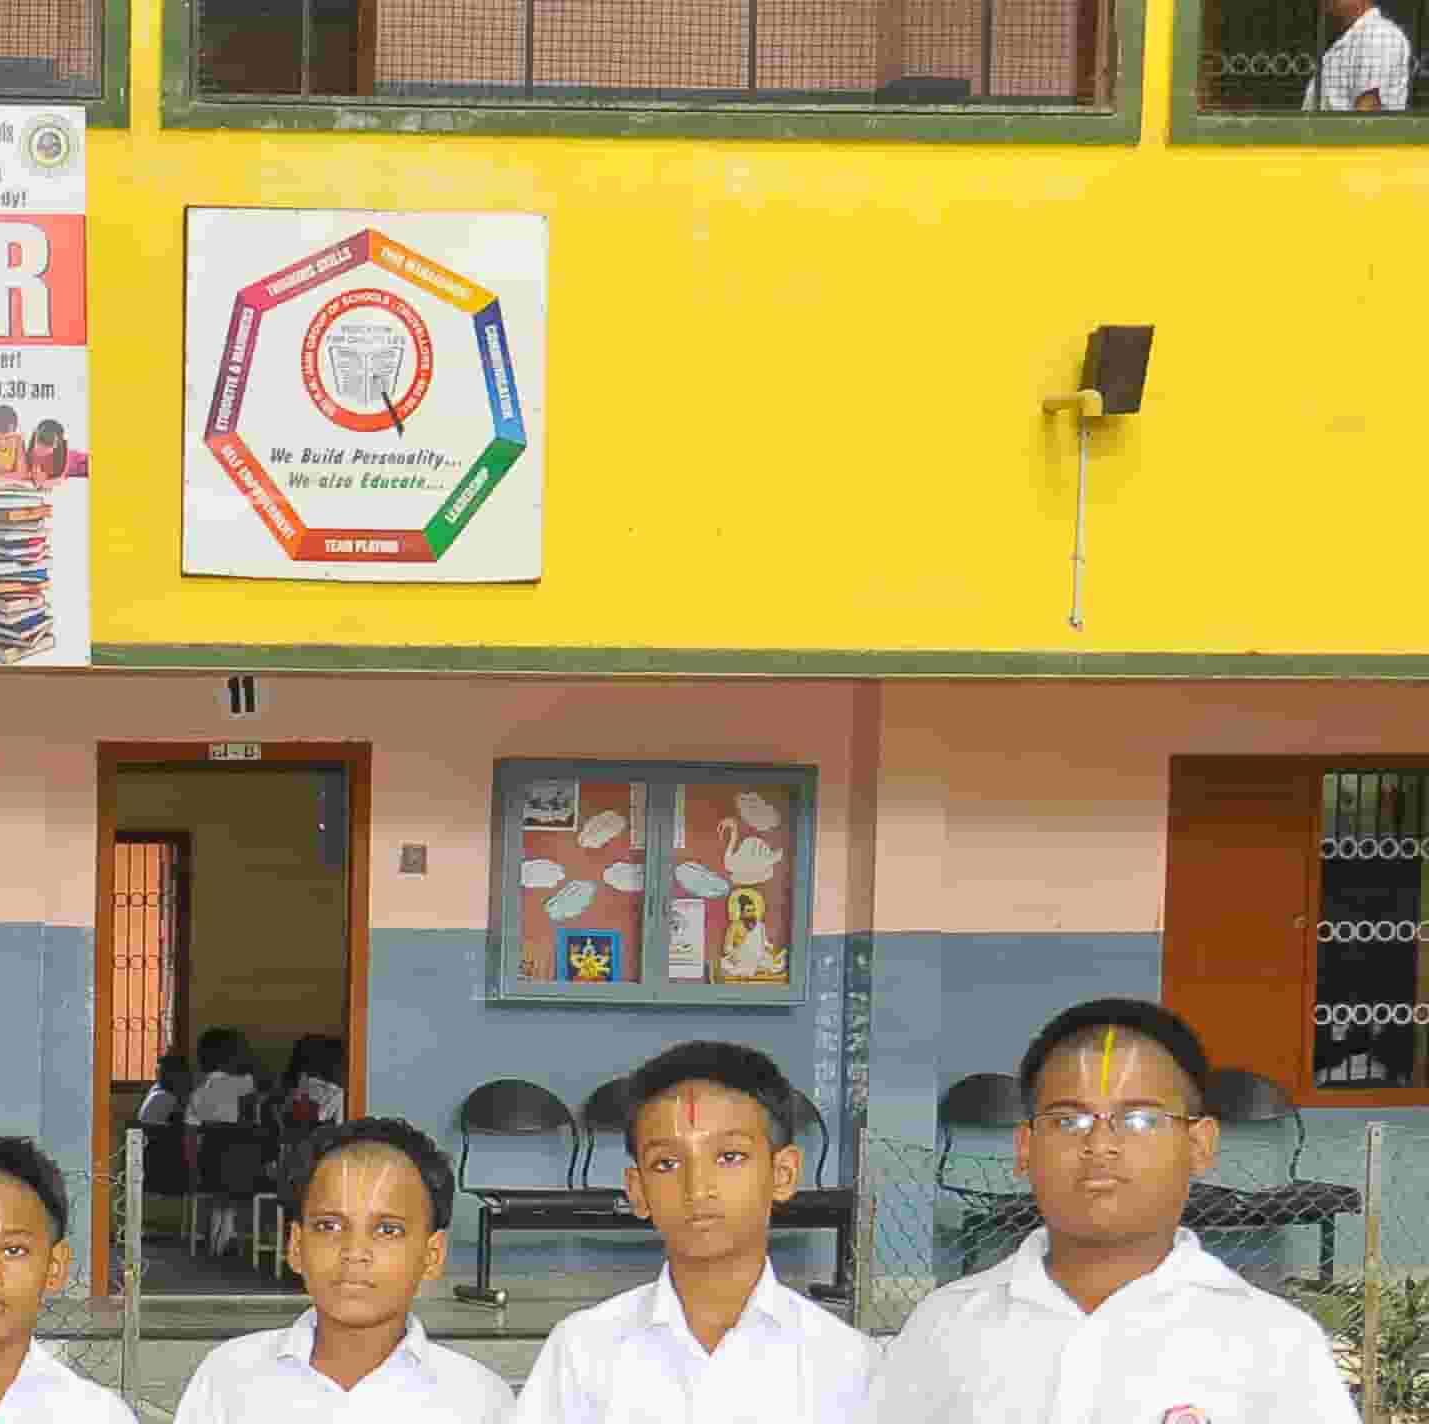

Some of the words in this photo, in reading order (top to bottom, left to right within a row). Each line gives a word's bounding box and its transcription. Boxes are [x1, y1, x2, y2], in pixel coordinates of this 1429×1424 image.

[30, 384, 56, 400] am
[270, 448, 294, 464] We
[301, 448, 341, 464] Build
[287, 472, 310, 489] We
[318, 472, 353, 489] also
[227, 675, 256, 714] 11
